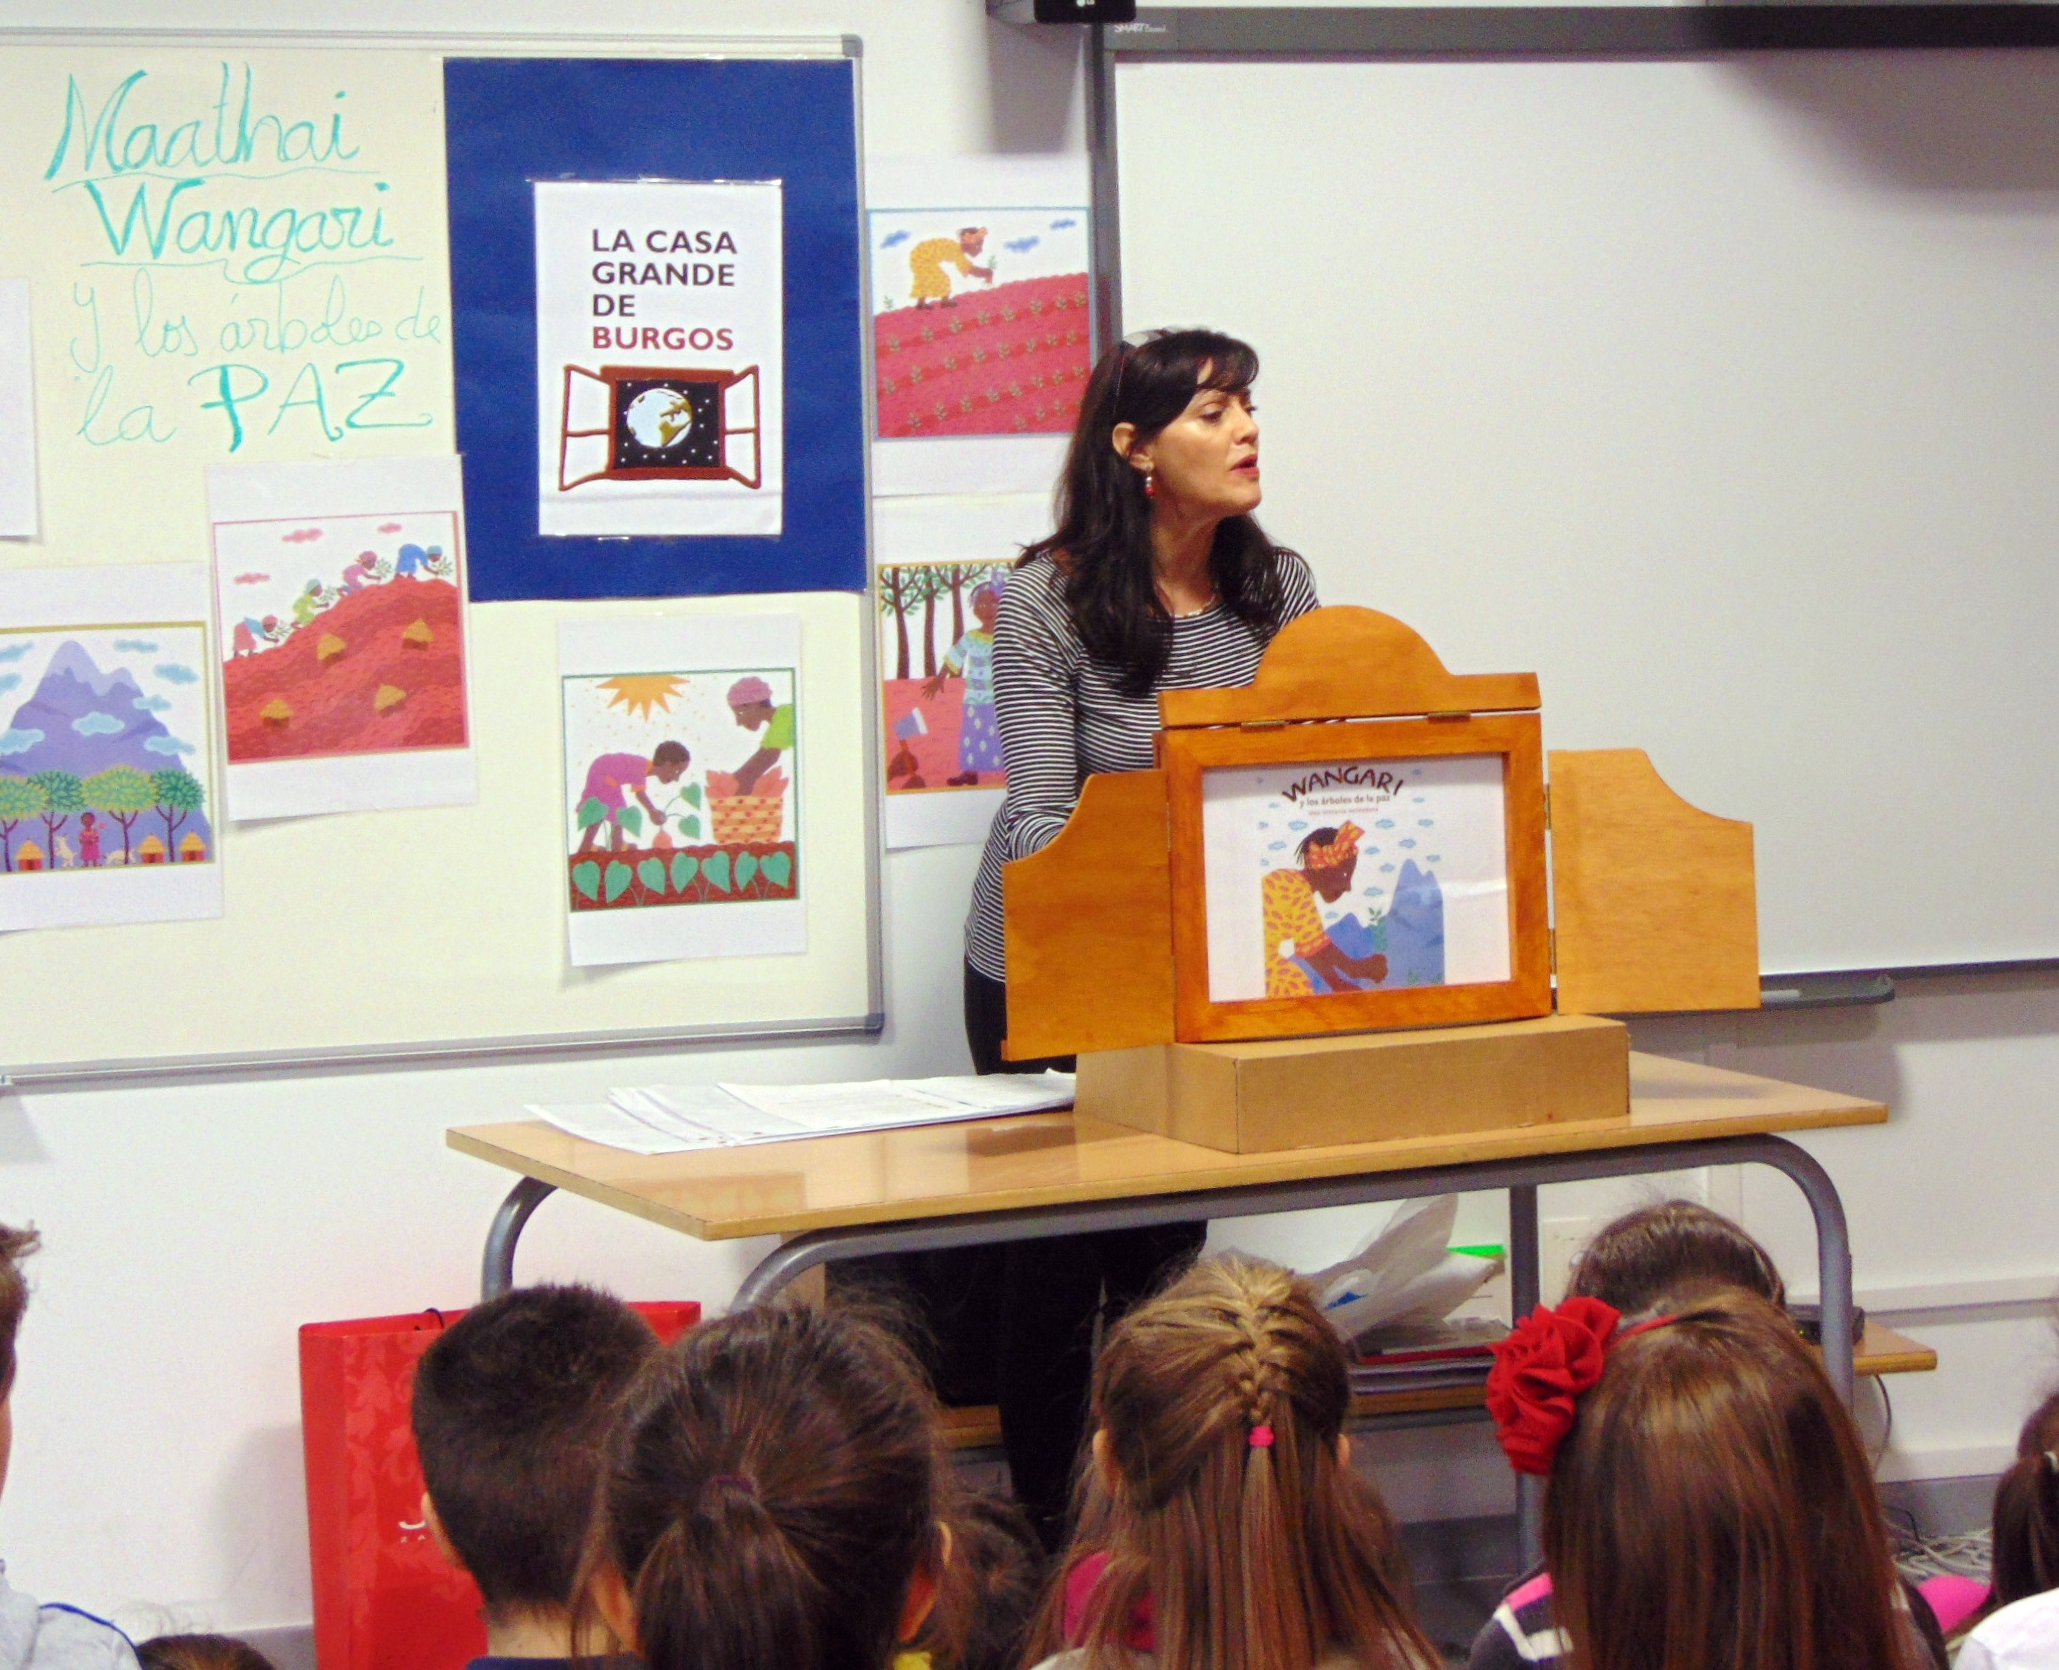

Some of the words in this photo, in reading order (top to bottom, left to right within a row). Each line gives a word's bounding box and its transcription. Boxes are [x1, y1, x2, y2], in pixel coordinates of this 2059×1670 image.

[44, 61, 360, 180] Maathai
[85, 178, 394, 284] Wangari
[592, 228, 635, 253] LA
[646, 229, 738, 255] CASA
[592, 261, 736, 287] GRANDE
[134, 267, 198, 357] los
[395, 285, 442, 344] de
[592, 293, 636, 317] DE
[592, 326, 735, 351] BURGOS
[77, 364, 177, 446] la
[188, 357, 434, 453] PAZ
[1281, 766, 1404, 803] WANGARI
[1306, 797, 1319, 806] los
[1321, 795, 1352, 805] árboles
[1354, 794, 1365, 803] de
[1366, 793, 1374, 802] la
[1376, 794, 1391, 804] paz
